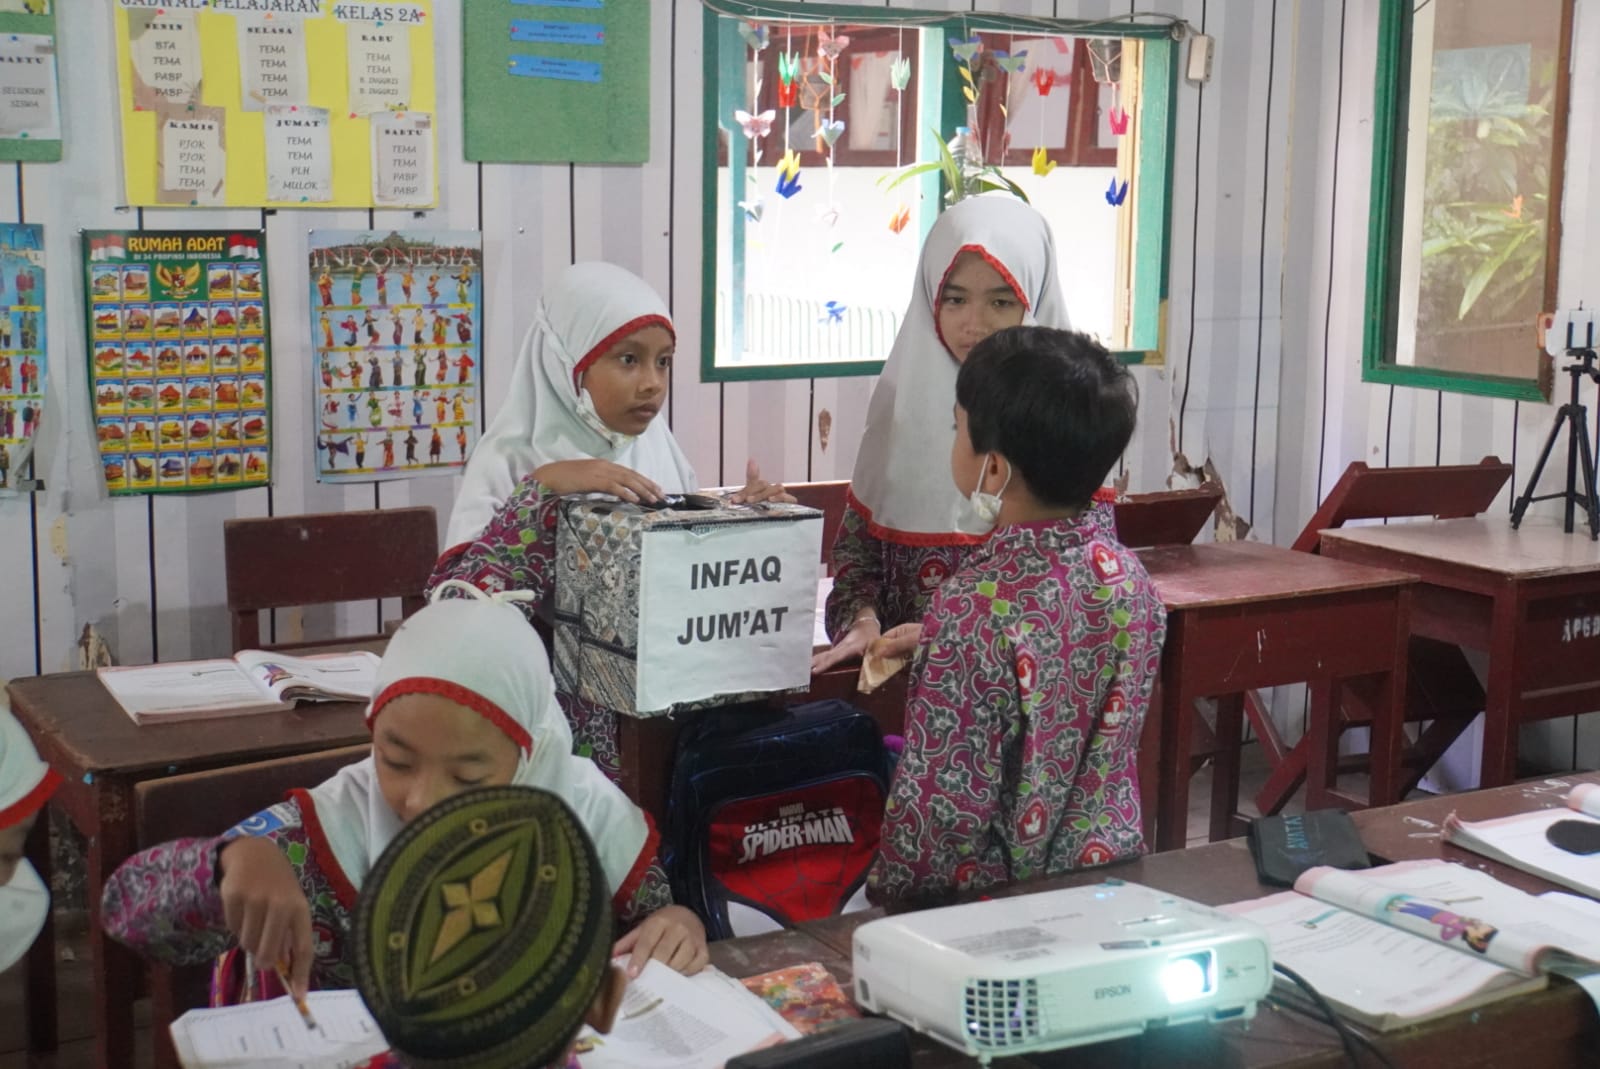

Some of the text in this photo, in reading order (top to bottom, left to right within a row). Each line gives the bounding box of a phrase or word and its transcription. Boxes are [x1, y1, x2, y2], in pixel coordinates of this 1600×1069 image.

[336, 5, 394, 21] KELAS
[399, 8, 420, 22] 2A
[259, 45, 286, 54] TEMA
[152, 57, 181, 66] TEMA
[365, 53, 391, 62] TEMA
[260, 59, 287, 68] TEMA
[366, 66, 392, 74] TEMA
[261, 74, 288, 82] TEMA
[262, 88, 289, 97] TEMA
[169, 121, 214, 131] KAMIS
[179, 139, 206, 150] PJOK
[286, 136, 312, 145] TEMA
[392, 145, 417, 154] TEMA
[179, 153, 206, 162] PJOK
[287, 151, 313, 160] TEMA
[392, 159, 417, 167] TEMA
[179, 165, 206, 174] TEMA
[291, 166, 310, 175] PLH
[178, 178, 205, 187] TEMA
[282, 181, 319, 190] MULOK
[128, 236, 225, 252] RUMAH ADAT
[312, 247, 476, 268] INDONESIA
[690, 556, 782, 590] INFAQ
[677, 606, 789, 645] JUM'AT
[743, 807, 844, 833] ULTIMATE
[737, 813, 855, 864] SPIDER-MAN
[1094, 984, 1132, 1000] EPSON
